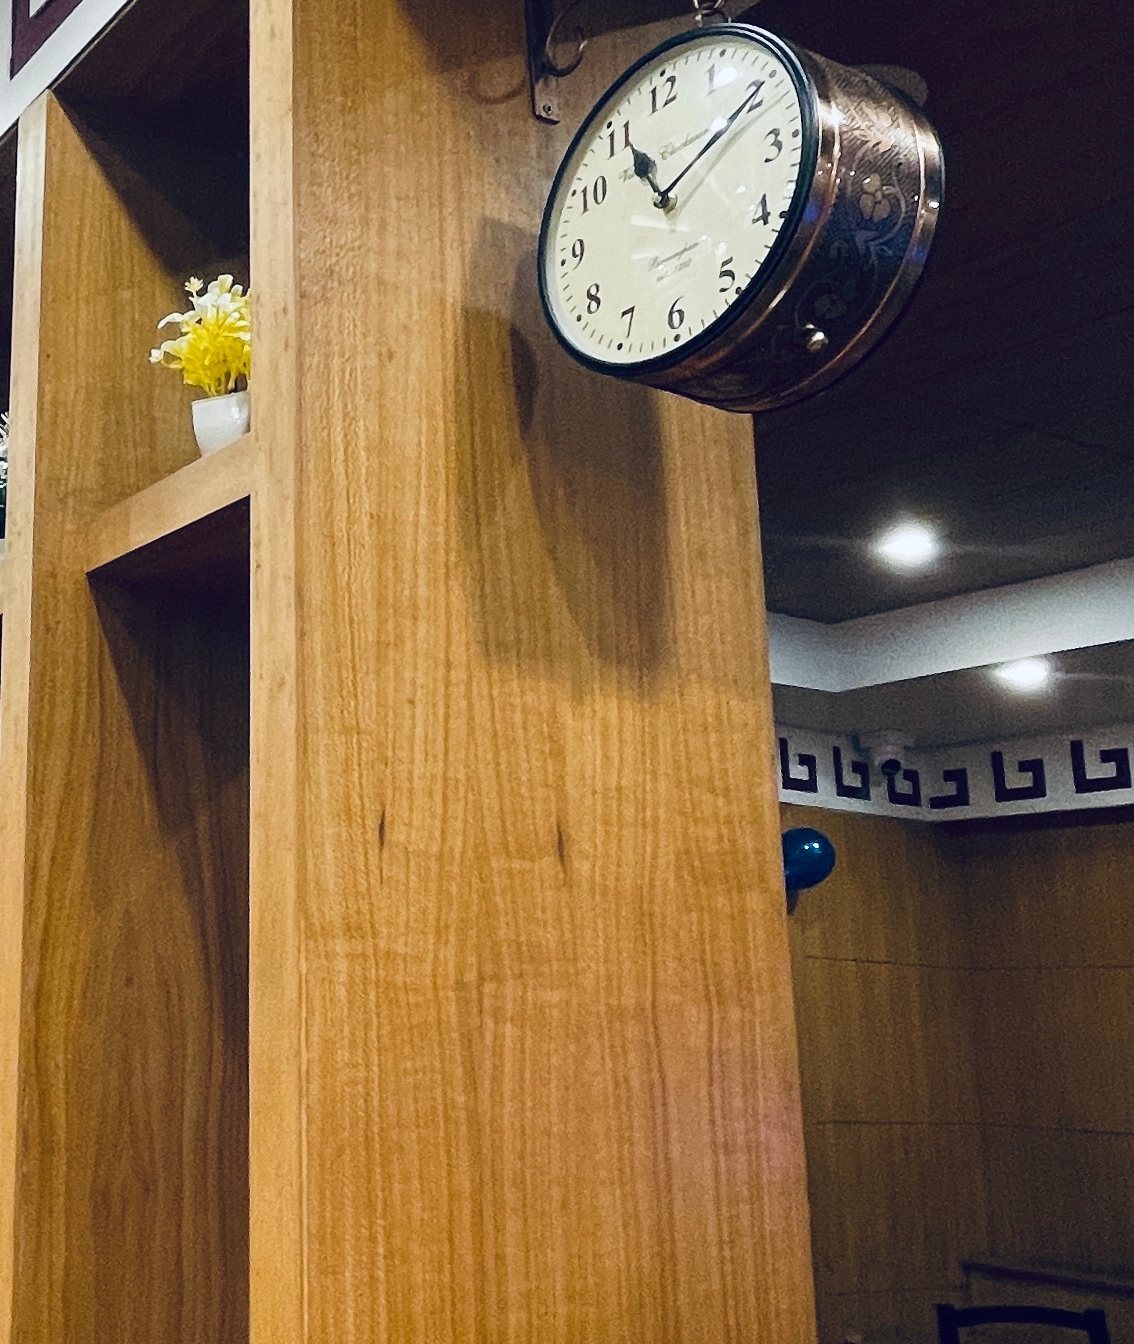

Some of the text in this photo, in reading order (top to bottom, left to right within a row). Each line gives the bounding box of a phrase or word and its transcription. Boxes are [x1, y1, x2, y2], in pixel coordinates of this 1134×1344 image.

[649, 75, 679, 116] 12
[705, 63, 716, 96] 1
[745, 78, 766, 115] 2
[607, 119, 630, 160] 11
[764, 127, 784, 164] 3
[580, 175, 607, 215] 10
[751, 193, 771, 226] 4
[571, 238, 585, 269] 9
[718, 256, 736, 294] 5
[585, 282, 602, 316] 8
[667, 296, 685, 330] 6
[619, 305, 635, 338] 7
